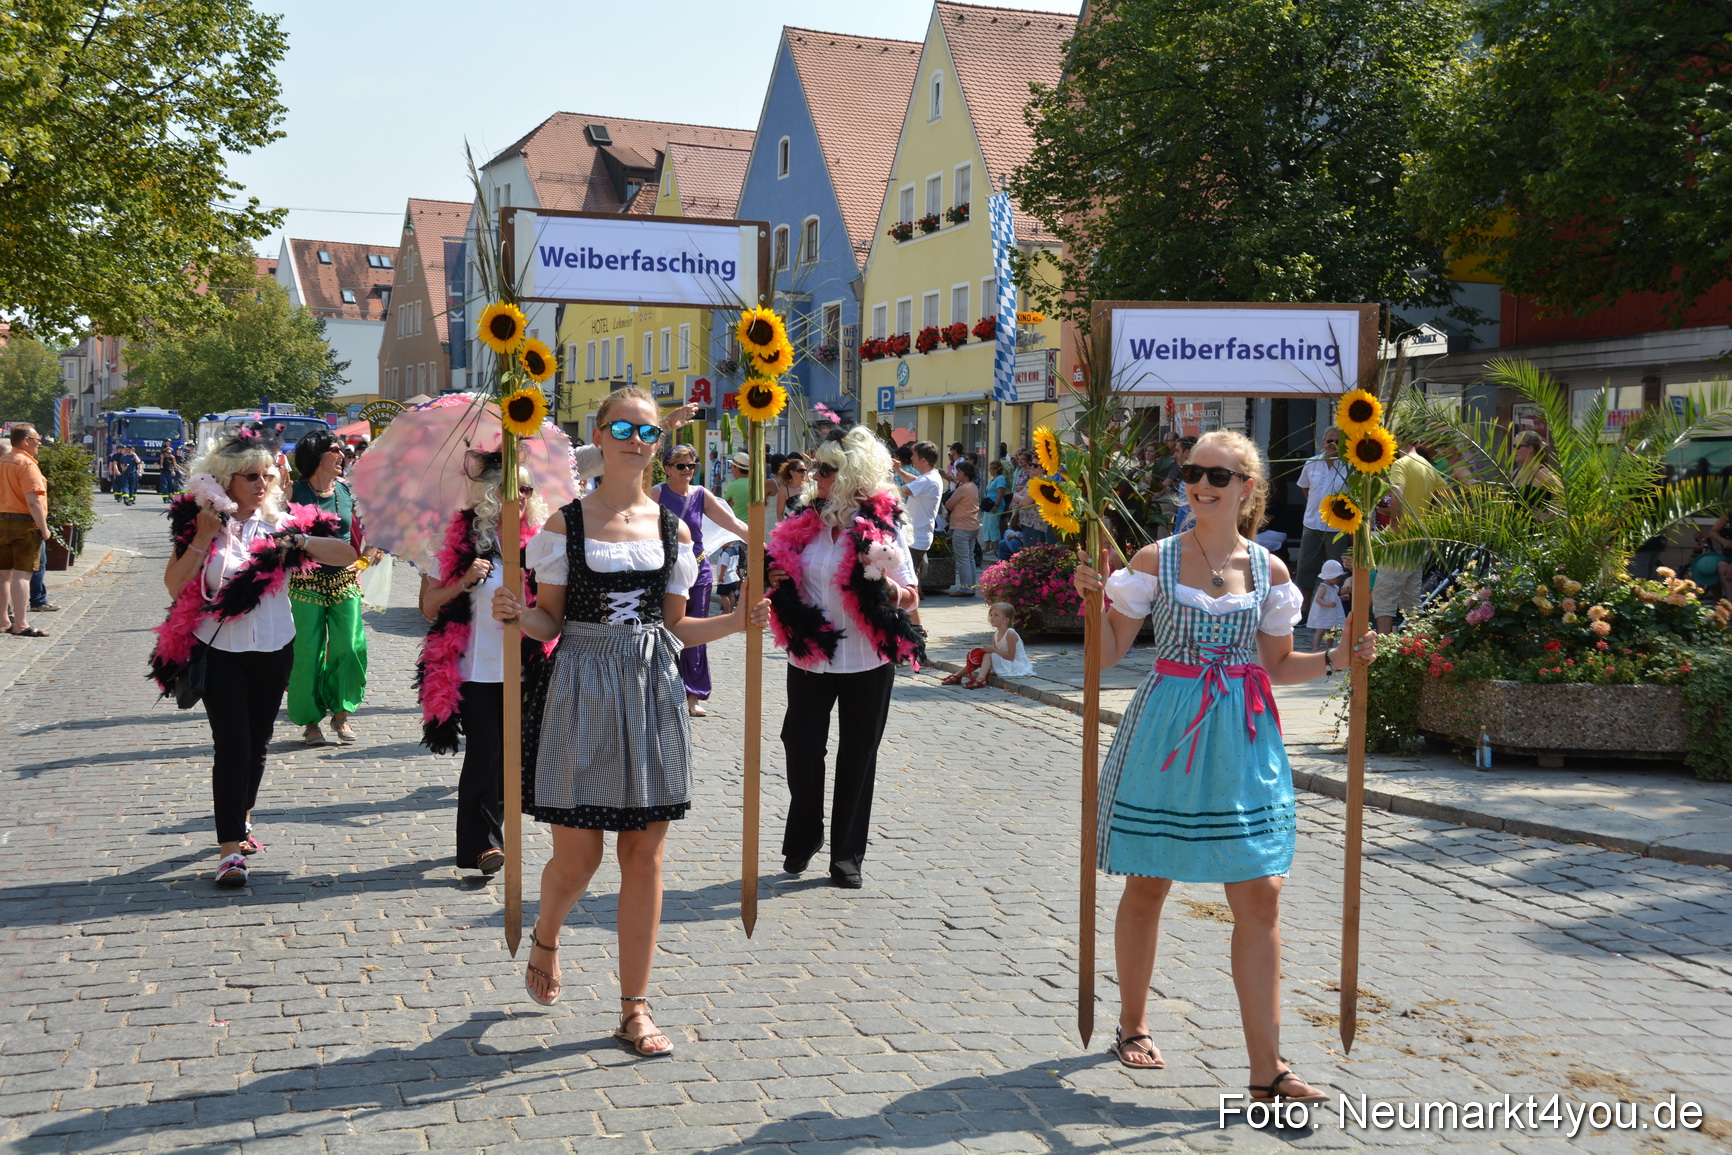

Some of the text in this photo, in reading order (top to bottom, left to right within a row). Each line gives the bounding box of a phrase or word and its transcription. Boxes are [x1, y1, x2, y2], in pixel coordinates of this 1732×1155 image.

[539, 245, 736, 282] Weiberfasching
[591, 317, 609, 335] HOTEL
[1129, 337, 1340, 367] Weiberfasching
[881, 389, 892, 410] P
[369, 411, 395, 423] Pilsac
[143, 440, 163, 448] THW
